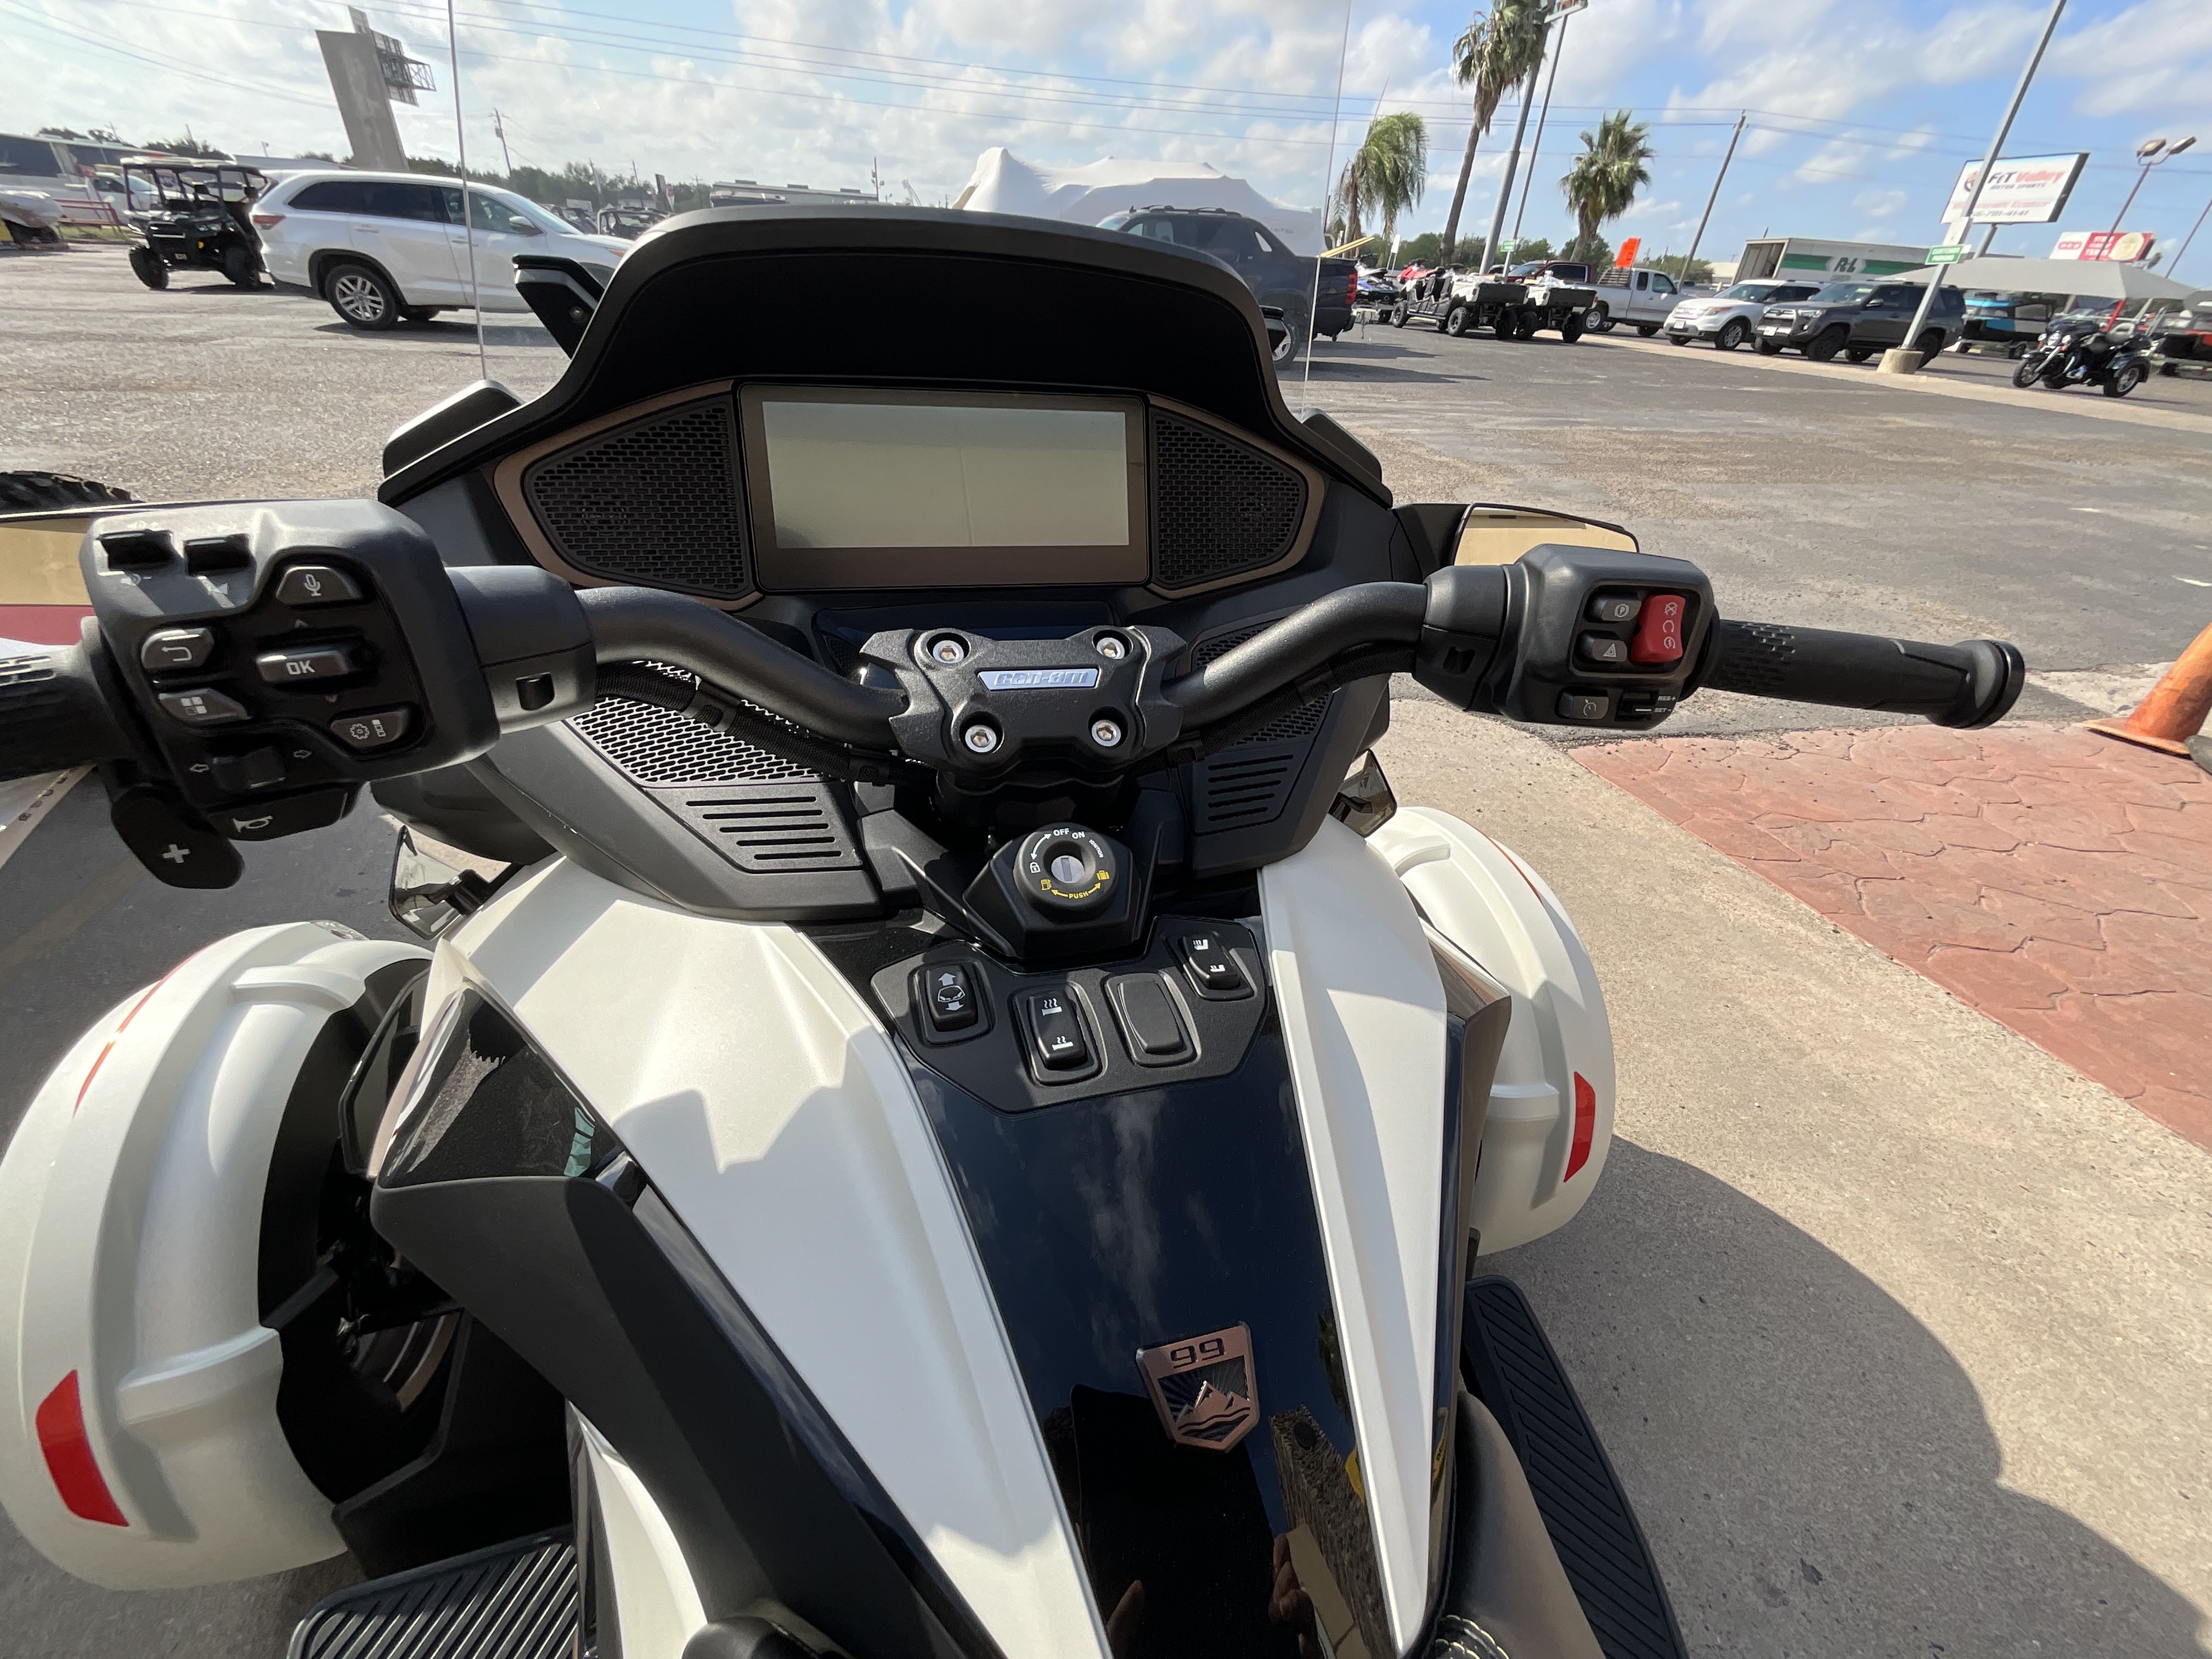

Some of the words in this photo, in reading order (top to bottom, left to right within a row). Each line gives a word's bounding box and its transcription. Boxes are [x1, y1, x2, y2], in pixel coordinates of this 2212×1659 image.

[2016, 171, 2065, 184] Valley
[286, 660, 315, 675] OK
[1053, 828, 1070, 836] OFF
[1071, 831, 1085, 839] ON
[1088, 839, 1104, 858] IGNITION
[1069, 890, 1089, 899] PUSH
[1170, 1338, 1225, 1369] 99
